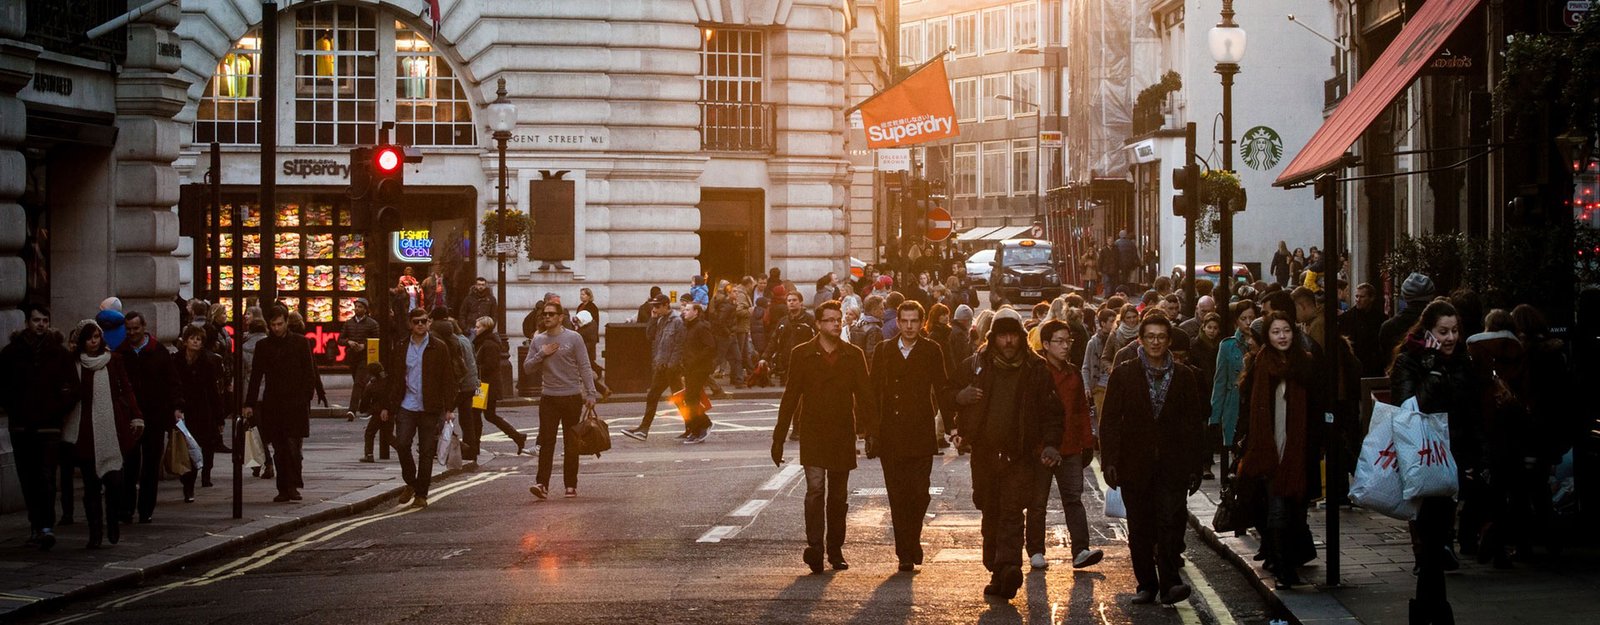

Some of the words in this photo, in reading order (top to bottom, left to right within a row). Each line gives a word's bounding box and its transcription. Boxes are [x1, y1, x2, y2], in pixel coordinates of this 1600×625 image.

[868, 115, 952, 143] Superdry
[507, 135, 540, 143] GENT
[548, 135, 584, 143] STREET
[283, 160, 351, 179] Superdry
[400, 230, 429, 240] T-SHIRT
[401, 239, 433, 248] GALLERY
[1374, 442, 1399, 473] H&
[1418, 438, 1450, 468] H&M
